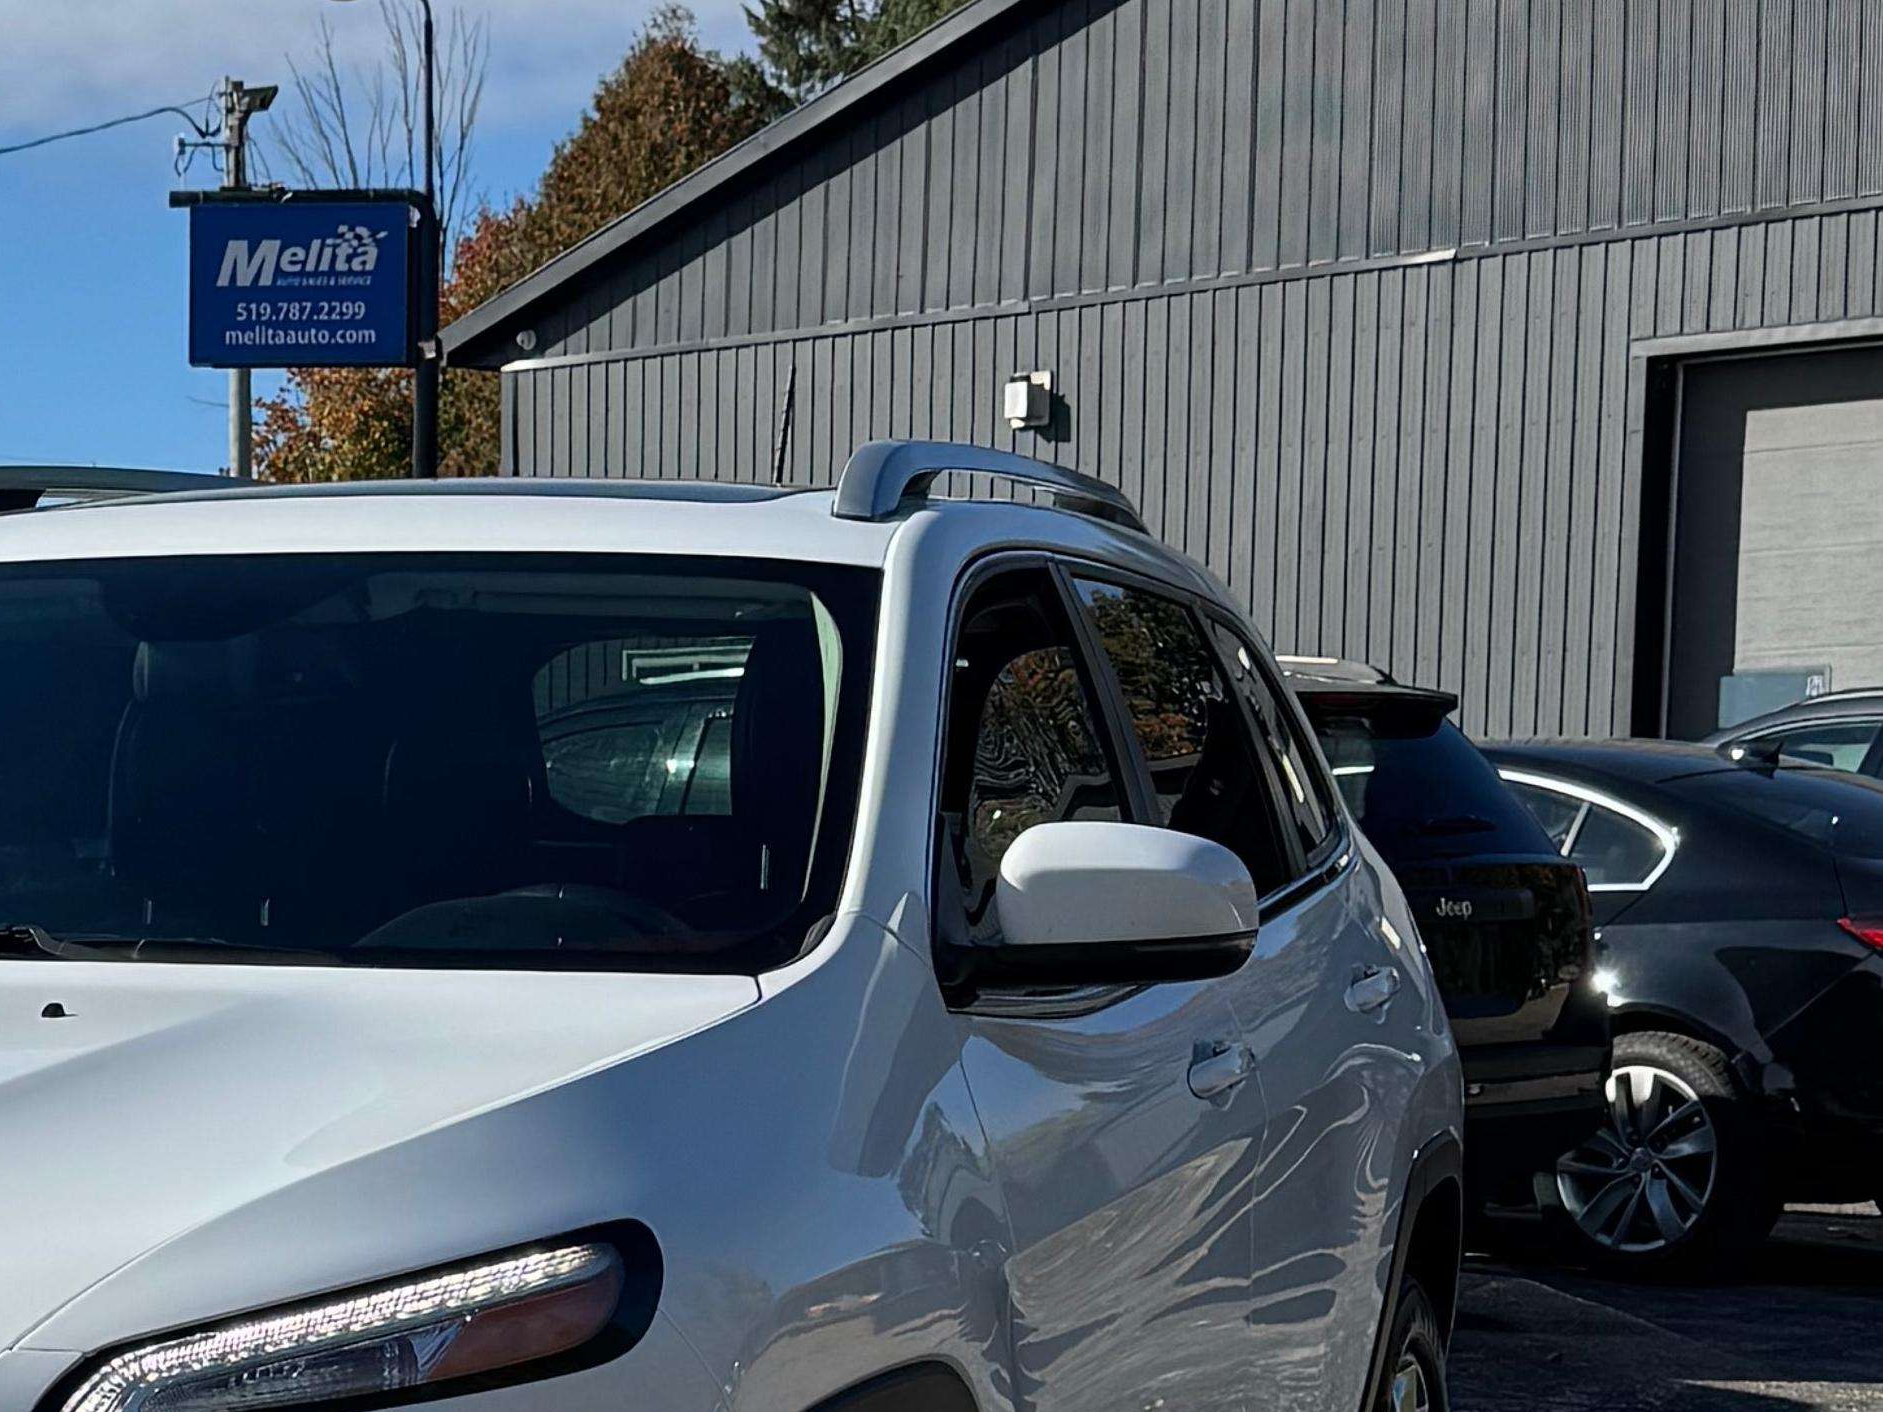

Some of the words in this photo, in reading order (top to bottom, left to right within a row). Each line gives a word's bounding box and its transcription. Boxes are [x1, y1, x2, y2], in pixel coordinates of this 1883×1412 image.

[217, 238, 379, 287] Melita
[236, 302, 366, 321] 519.787.2299
[224, 326, 376, 345] melitaauto.com
[1436, 897, 1473, 920] Jeep
